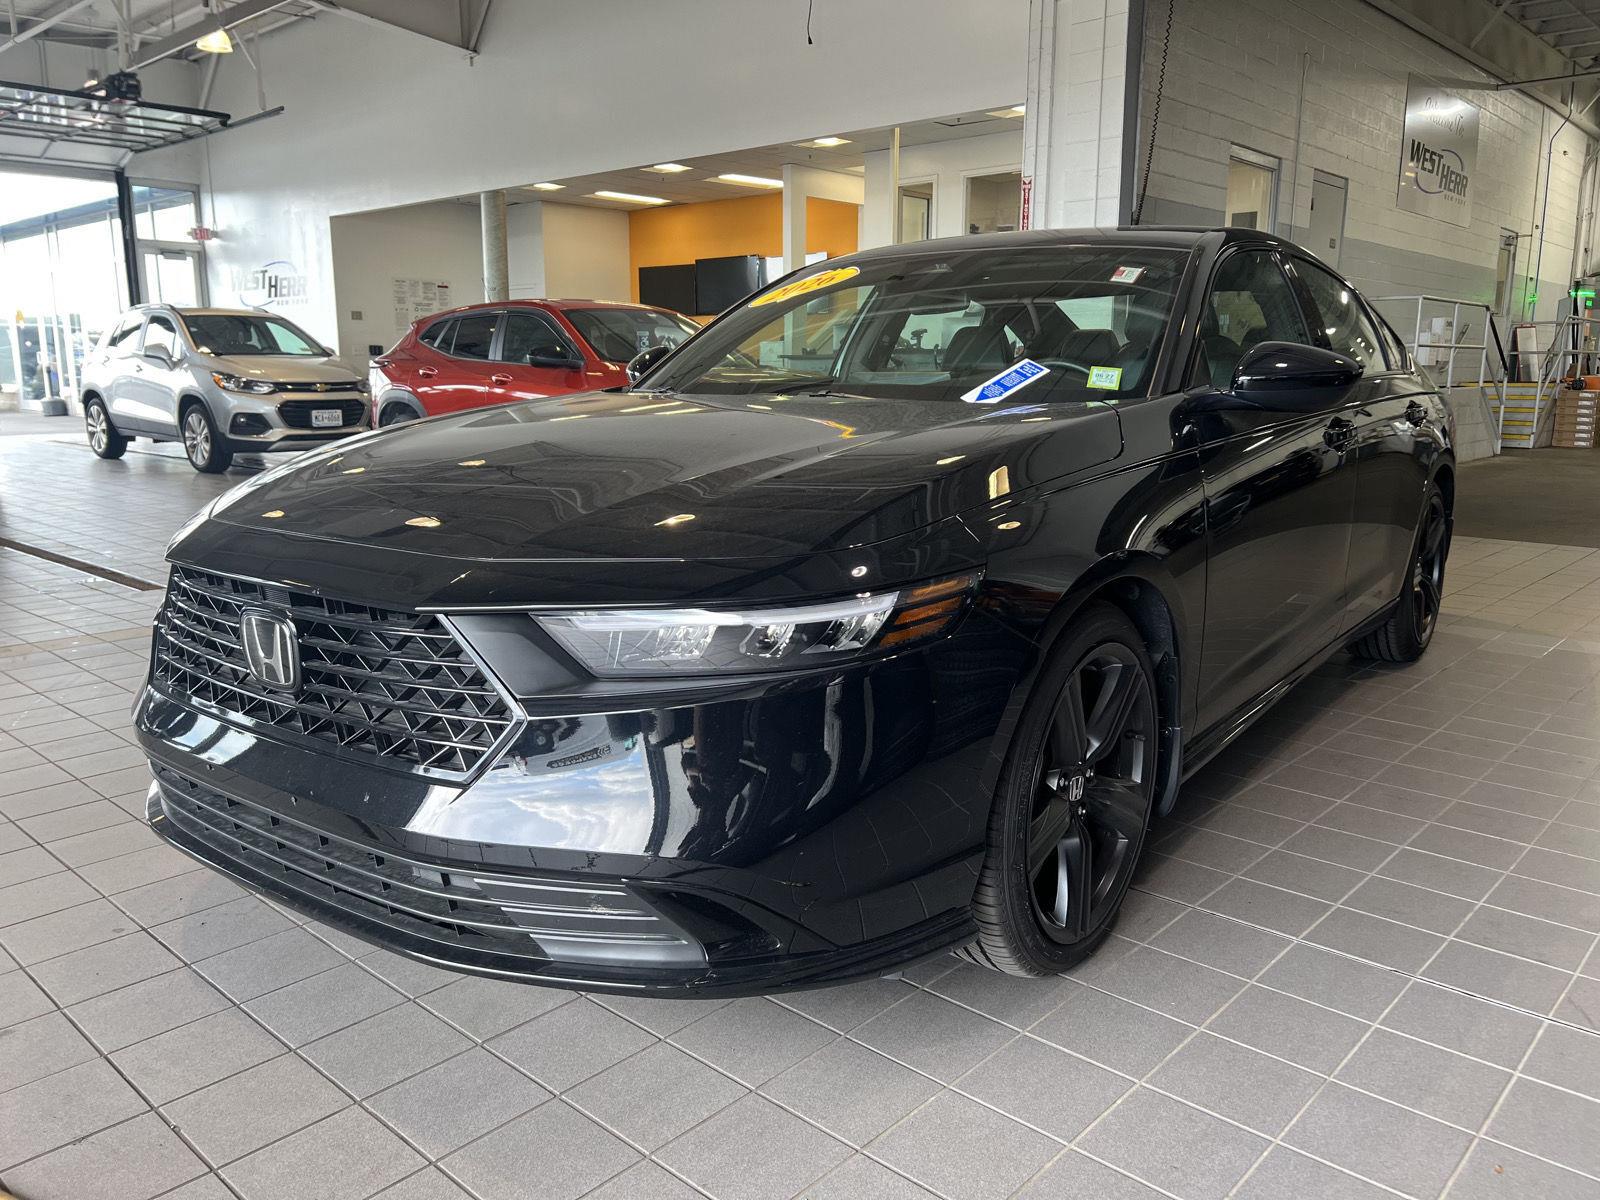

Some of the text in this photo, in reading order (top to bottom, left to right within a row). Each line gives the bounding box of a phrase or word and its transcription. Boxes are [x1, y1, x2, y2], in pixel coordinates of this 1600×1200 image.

[1410, 139, 1443, 176] WEST
[1439, 164, 1468, 197] HERR
[231, 267, 268, 292] WEST
[268, 275, 307, 298] HERR
